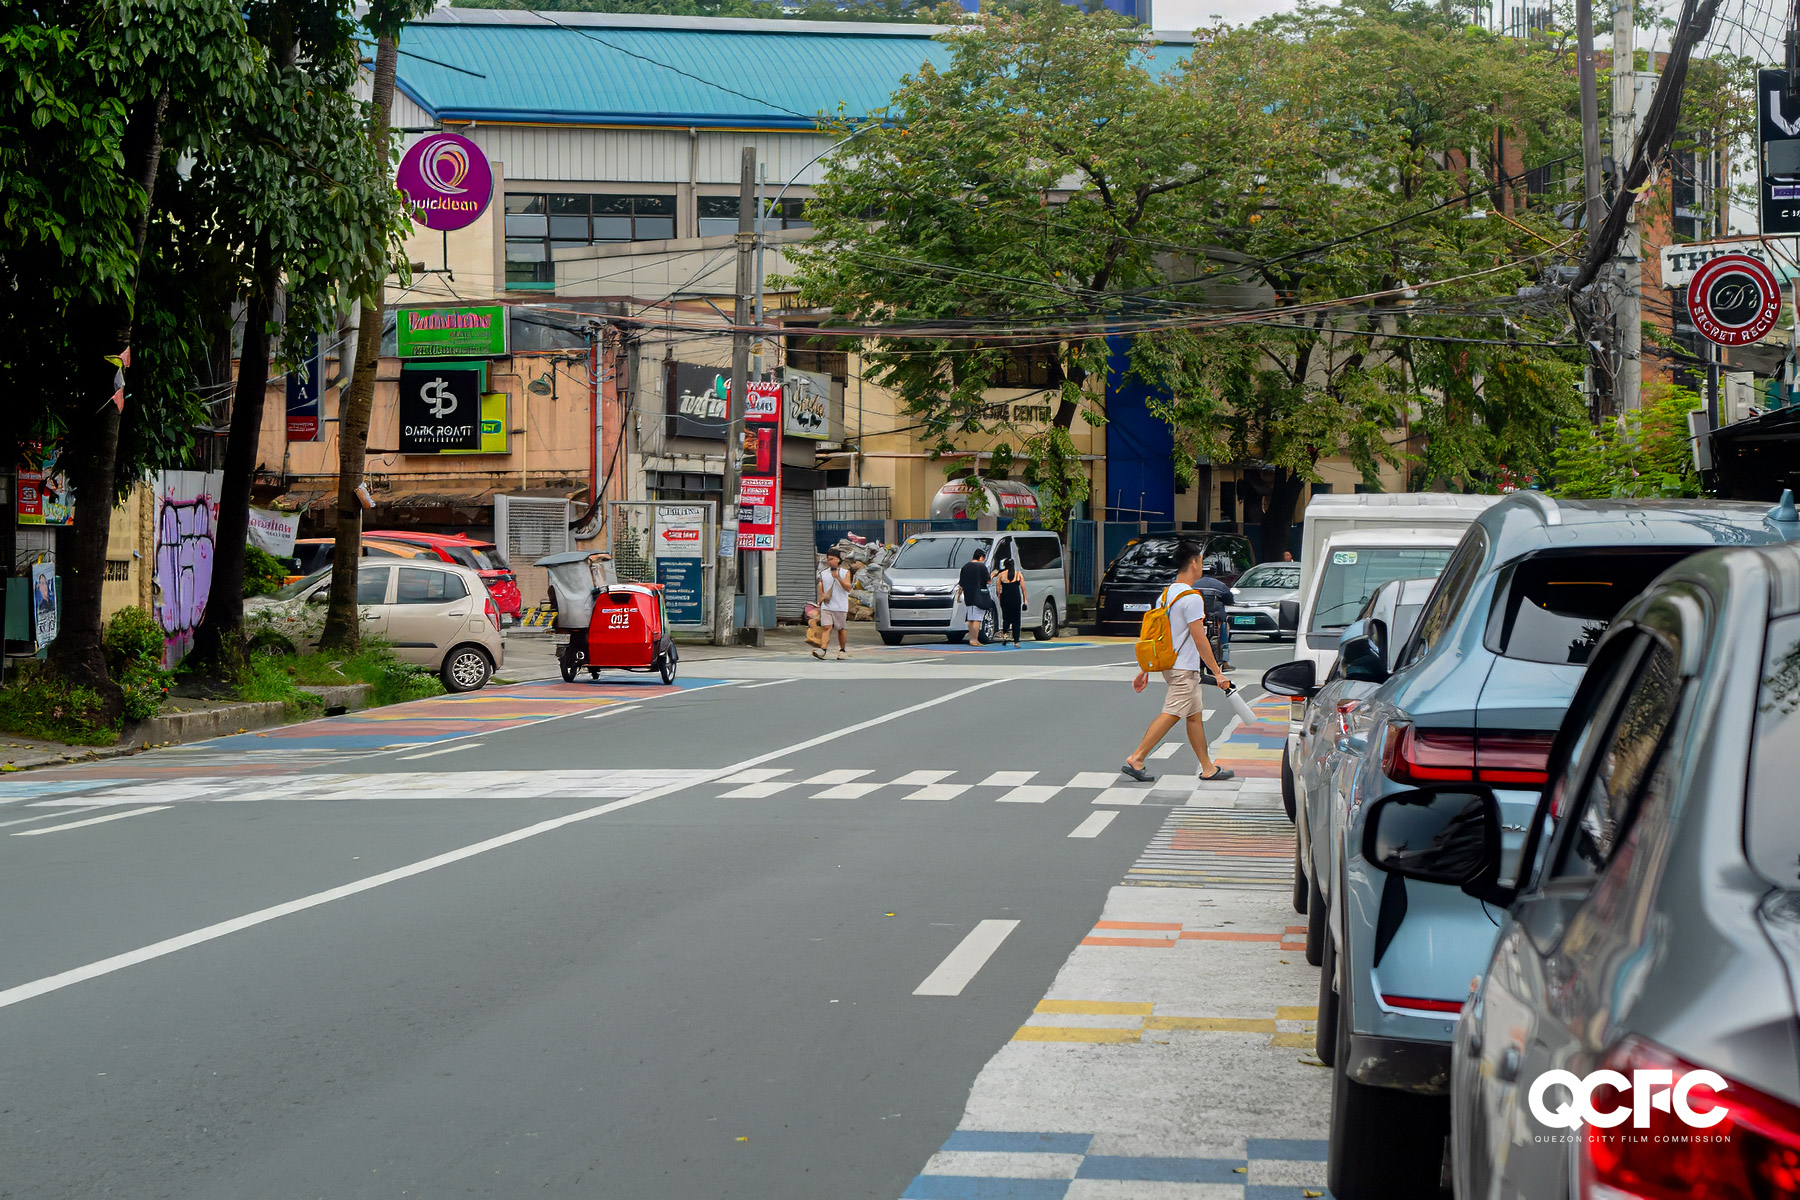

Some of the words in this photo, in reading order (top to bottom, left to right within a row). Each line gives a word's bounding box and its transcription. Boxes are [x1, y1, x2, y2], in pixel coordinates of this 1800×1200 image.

[1693, 305, 1737, 342] SECRET
[1740, 302, 1778, 341] RECIPE
[404, 425, 435, 437] DARK
